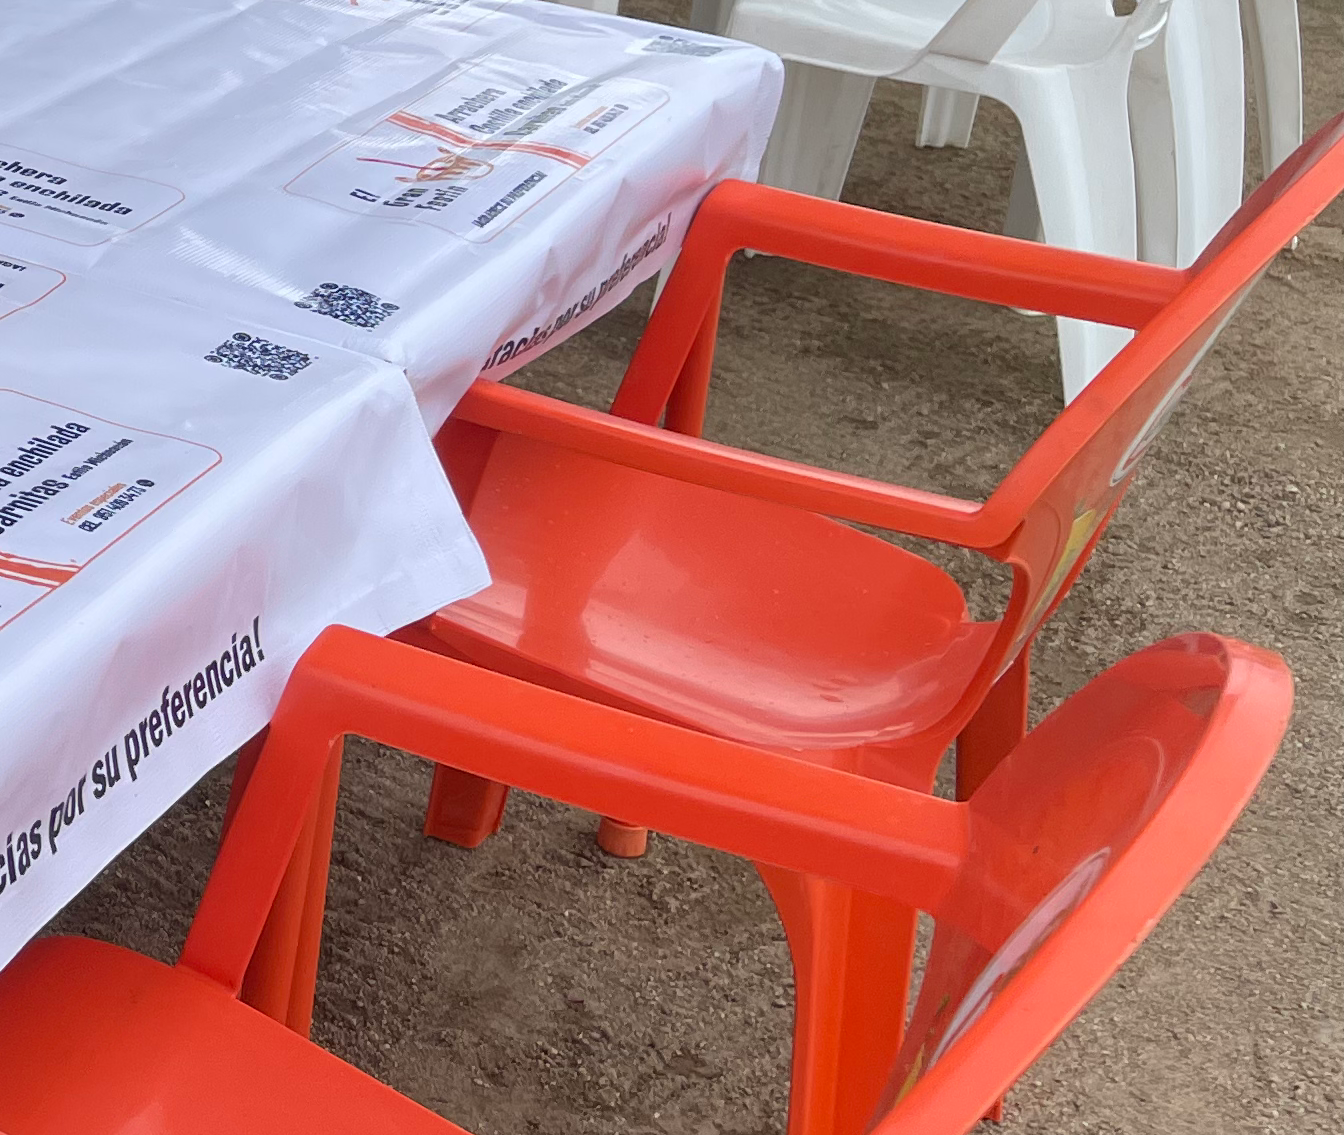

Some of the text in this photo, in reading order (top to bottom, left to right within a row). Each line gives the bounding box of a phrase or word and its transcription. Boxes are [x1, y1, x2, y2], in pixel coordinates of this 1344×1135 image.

[9, 180, 133, 217] enchilada
[0, 419, 91, 478] enchilada
[48, 771, 87, 855] por
[91, 745, 122, 800] su
[123, 615, 266, 783] preferencia!
